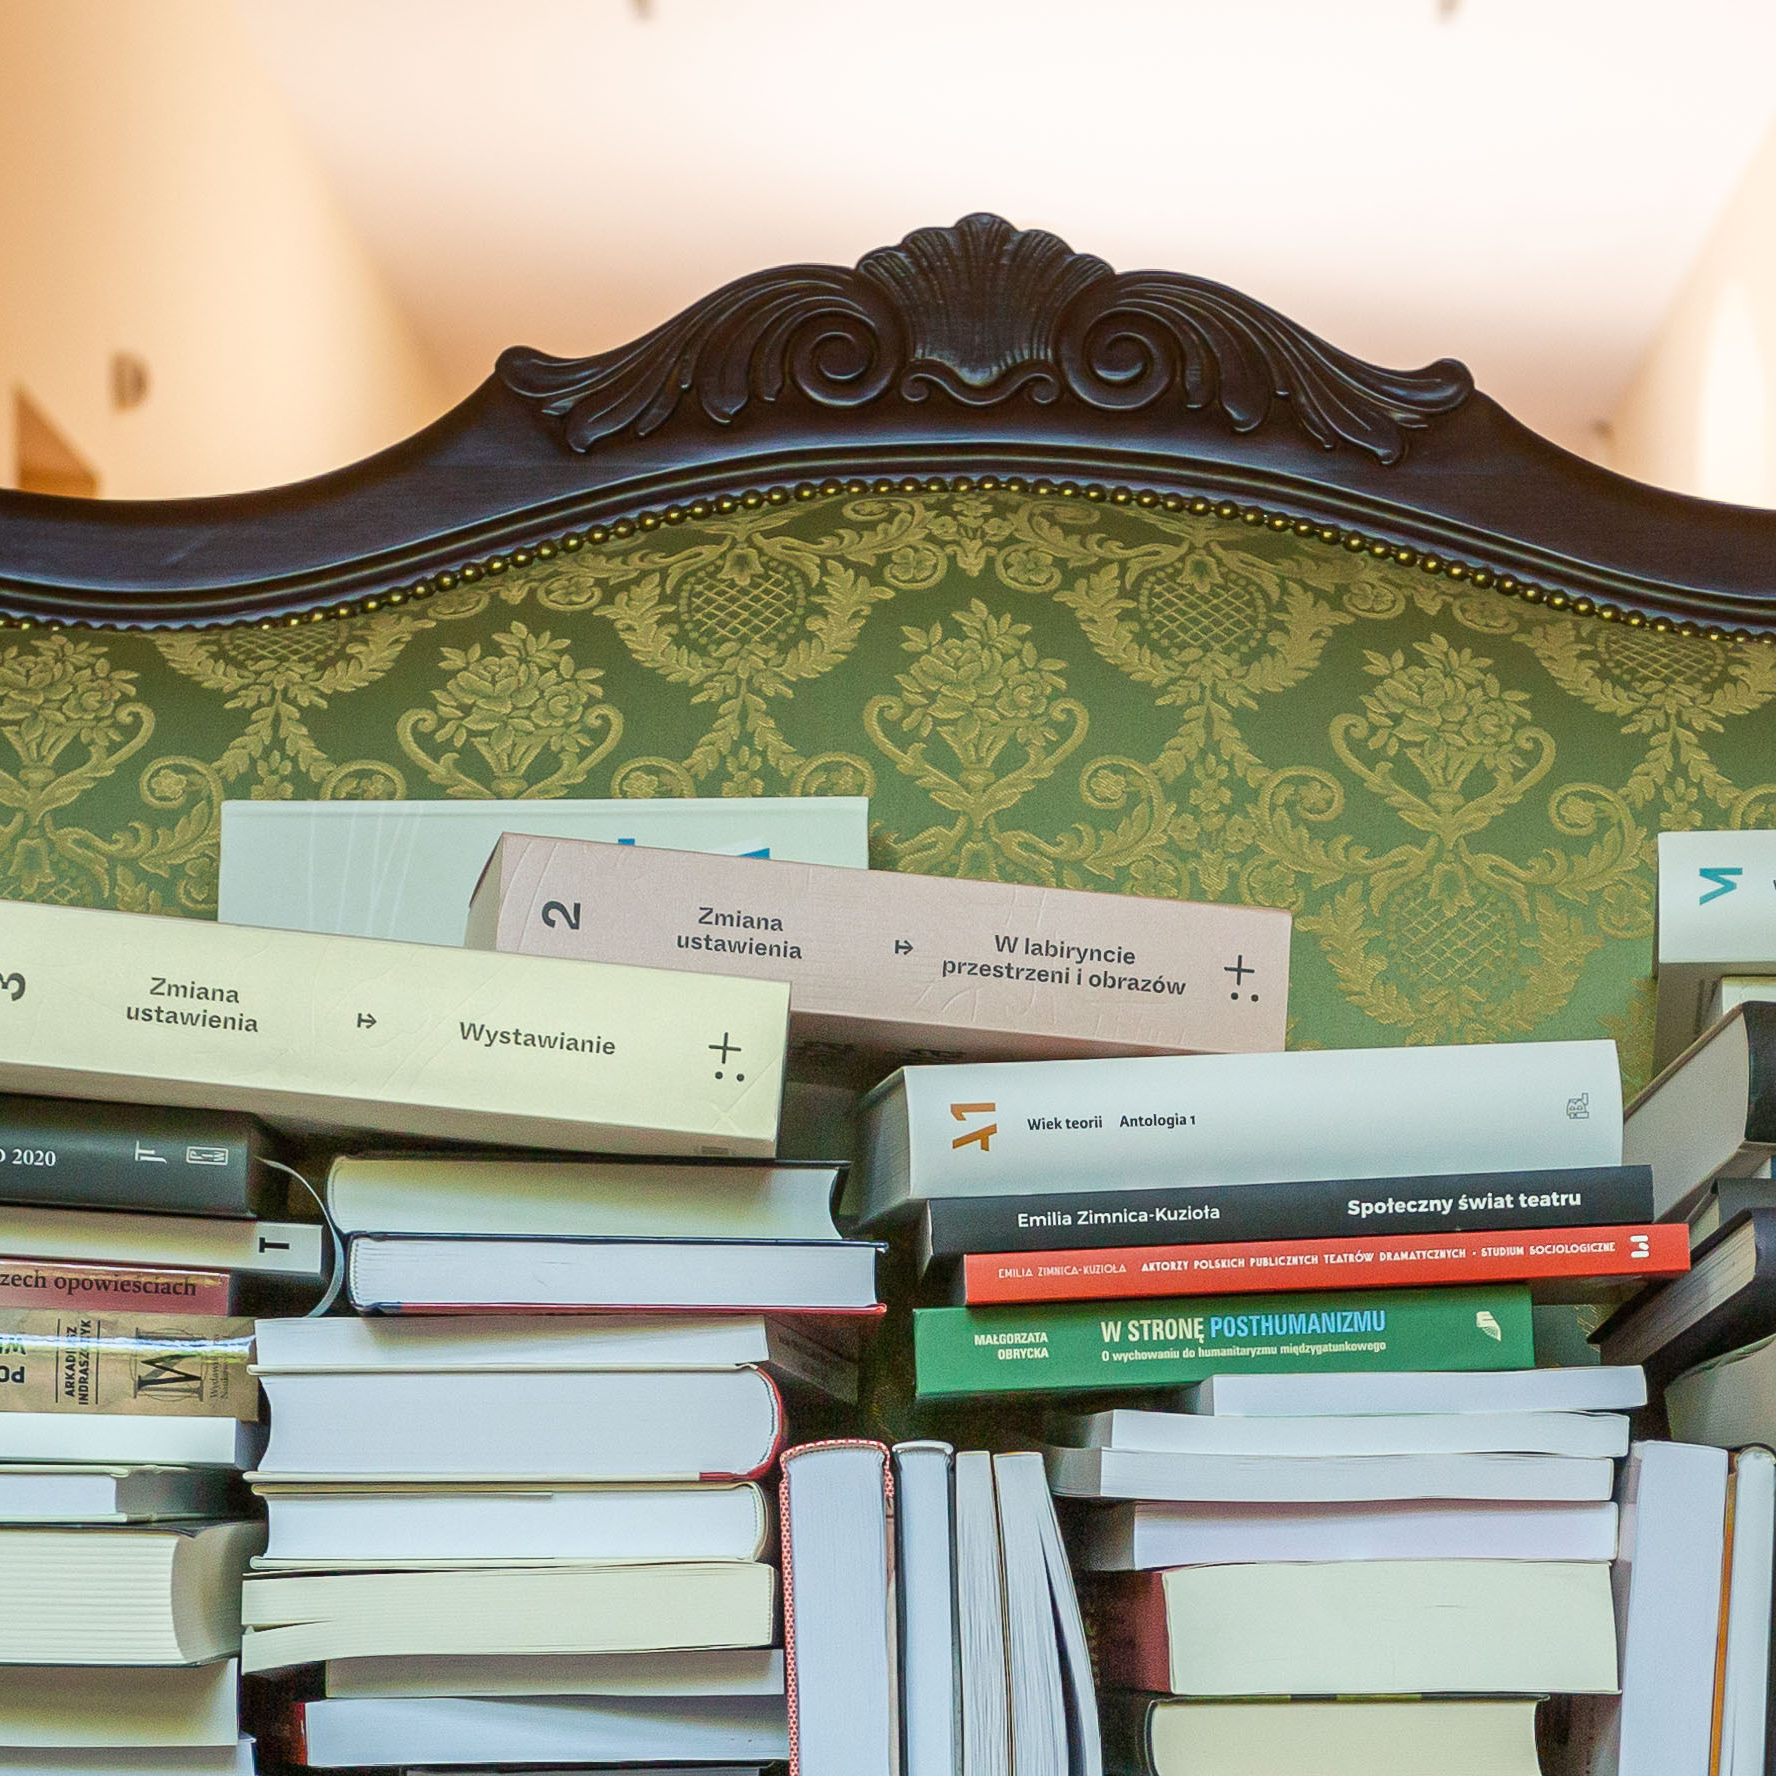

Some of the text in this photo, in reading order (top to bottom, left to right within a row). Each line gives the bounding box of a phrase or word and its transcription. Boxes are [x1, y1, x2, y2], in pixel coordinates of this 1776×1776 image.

[541, 900, 581, 930] 2
[698, 906, 784, 932] Zmiana
[676, 931, 803, 960] ustawienia
[994, 935, 1137, 969] W labiryncie
[941, 956, 1188, 996] przestrzeni i obrazów
[150, 976, 241, 1004] Zmiana
[125, 1003, 259, 1033] ustawienia
[459, 1021, 616, 1057] Wystawianie
[1027, 1114, 1103, 1131] Wiek teorii
[1119, 1111, 1196, 1133] Antologia 1
[12, 1148, 57, 1167] 2020
[1017, 1204, 1221, 1228] Emilia Zimnica-Kuzioła
[1347, 1190, 1582, 1219] Społeczny świat teatru
[998, 1264, 1127, 1278] EMILIA ZIMNICA-KUZIOŁA
[1141, 1261, 1188, 1272] AKTORZY
[1194, 1258, 1245, 1270] POLSKICH
[1250, 1255, 1318, 1268] PUBLICZNYCH
[1323, 1250, 1374, 1264] TEATRÓW
[1379, 1248, 1466, 1262] DRAMATYCZNYCH
[1481, 1246, 1524, 1257] STUDIUM
[55, 1270, 197, 1297] opowieściach
[974, 1330, 1049, 1348] MAŁGORZATA
[1101, 1310, 1386, 1344] W STRONĘ POSTHUMANIZMU
[65, 1326, 77, 1397] ARKADISZ
[78, 1320, 91, 1405] INDRASZYK
[997, 1345, 1049, 1361] OBRYCKA
[1102, 1341, 1386, 1362] O wychowaniu do humanitaryzmu międzygatunkowego
